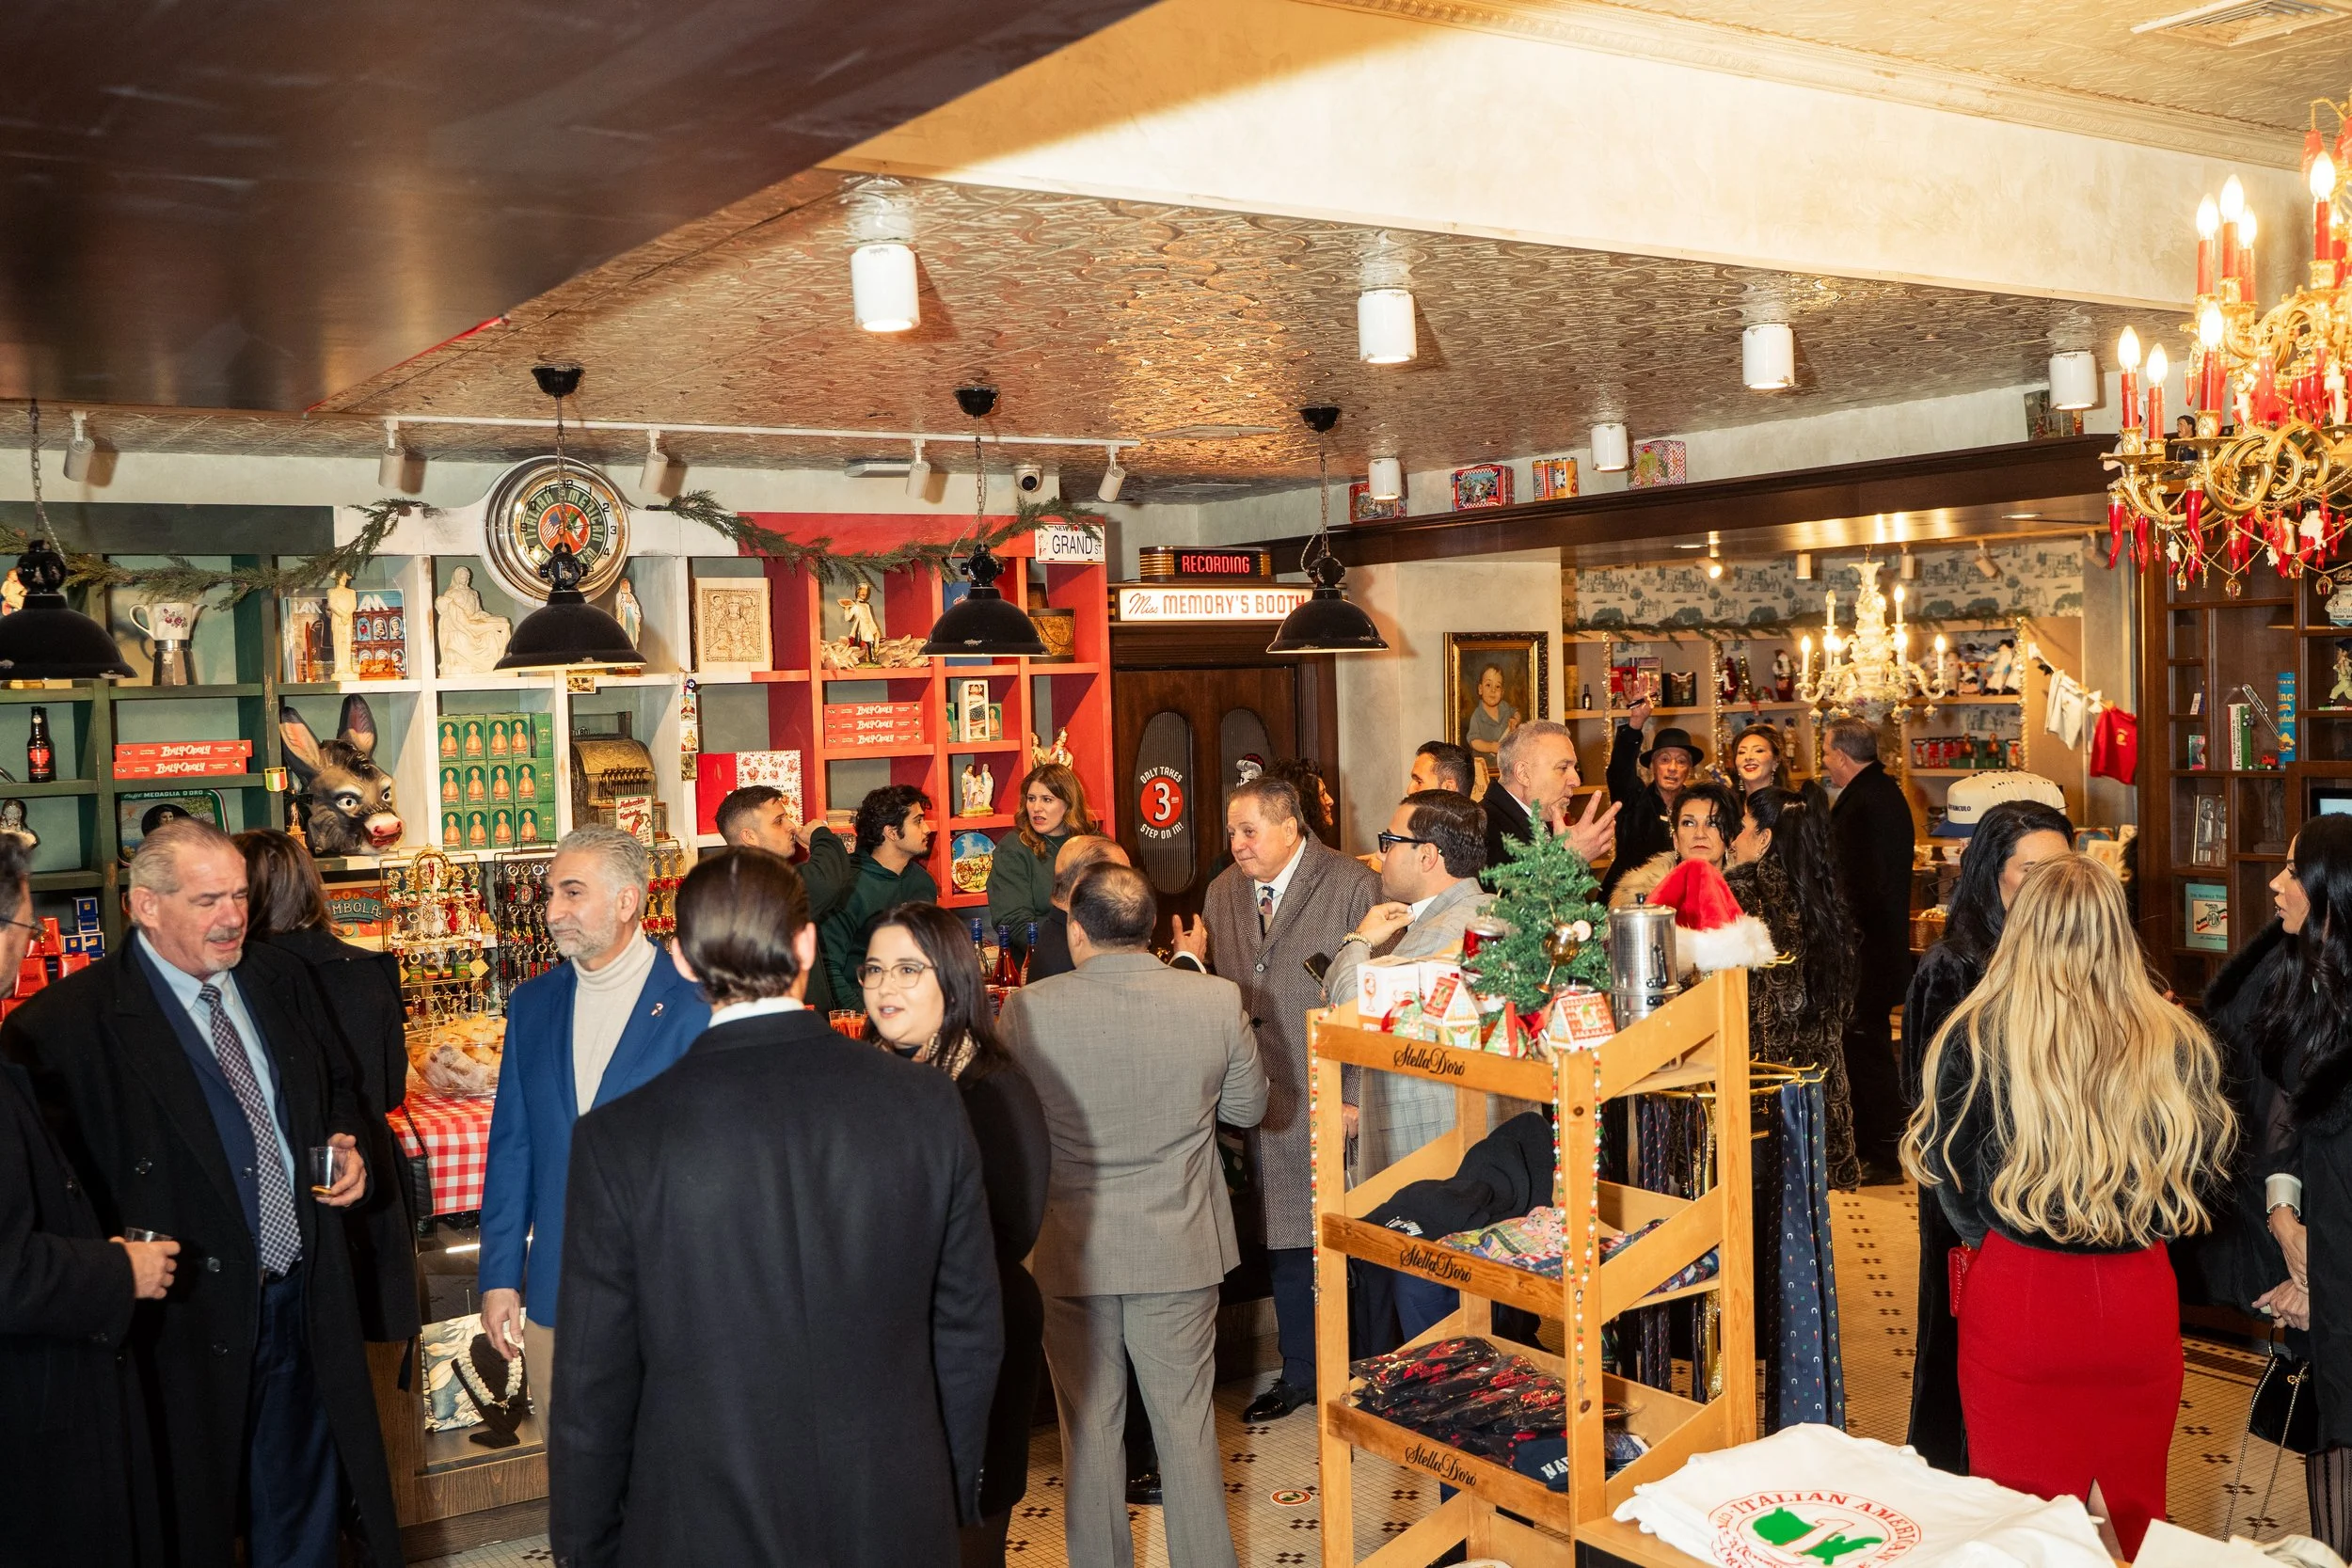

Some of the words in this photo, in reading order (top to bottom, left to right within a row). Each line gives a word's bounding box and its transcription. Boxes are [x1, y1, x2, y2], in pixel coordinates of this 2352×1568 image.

[525, 493, 554, 540] ITALIAN
[1052, 534, 1093, 555] GRAND
[1094, 544, 1103, 555] ST.
[1182, 555, 1250, 574] RECORDING
[356, 594, 389, 611] AM
[1128, 593, 1158, 614] Miss
[1163, 594, 1249, 614] MEMORY'S
[1255, 594, 1305, 614] BOOTH
[1139, 767, 1159, 784] ONLY
[1159, 766, 1184, 784] TAKES
[1153, 782, 1171, 821] 3
[1139, 823, 1159, 839] STEP
[1160, 829, 1172, 840] ON
[1172, 821, 1184, 836] IN!
[332, 901, 383, 919] MBOLA
[1733, 1492, 1848, 1514] ITALIAN
